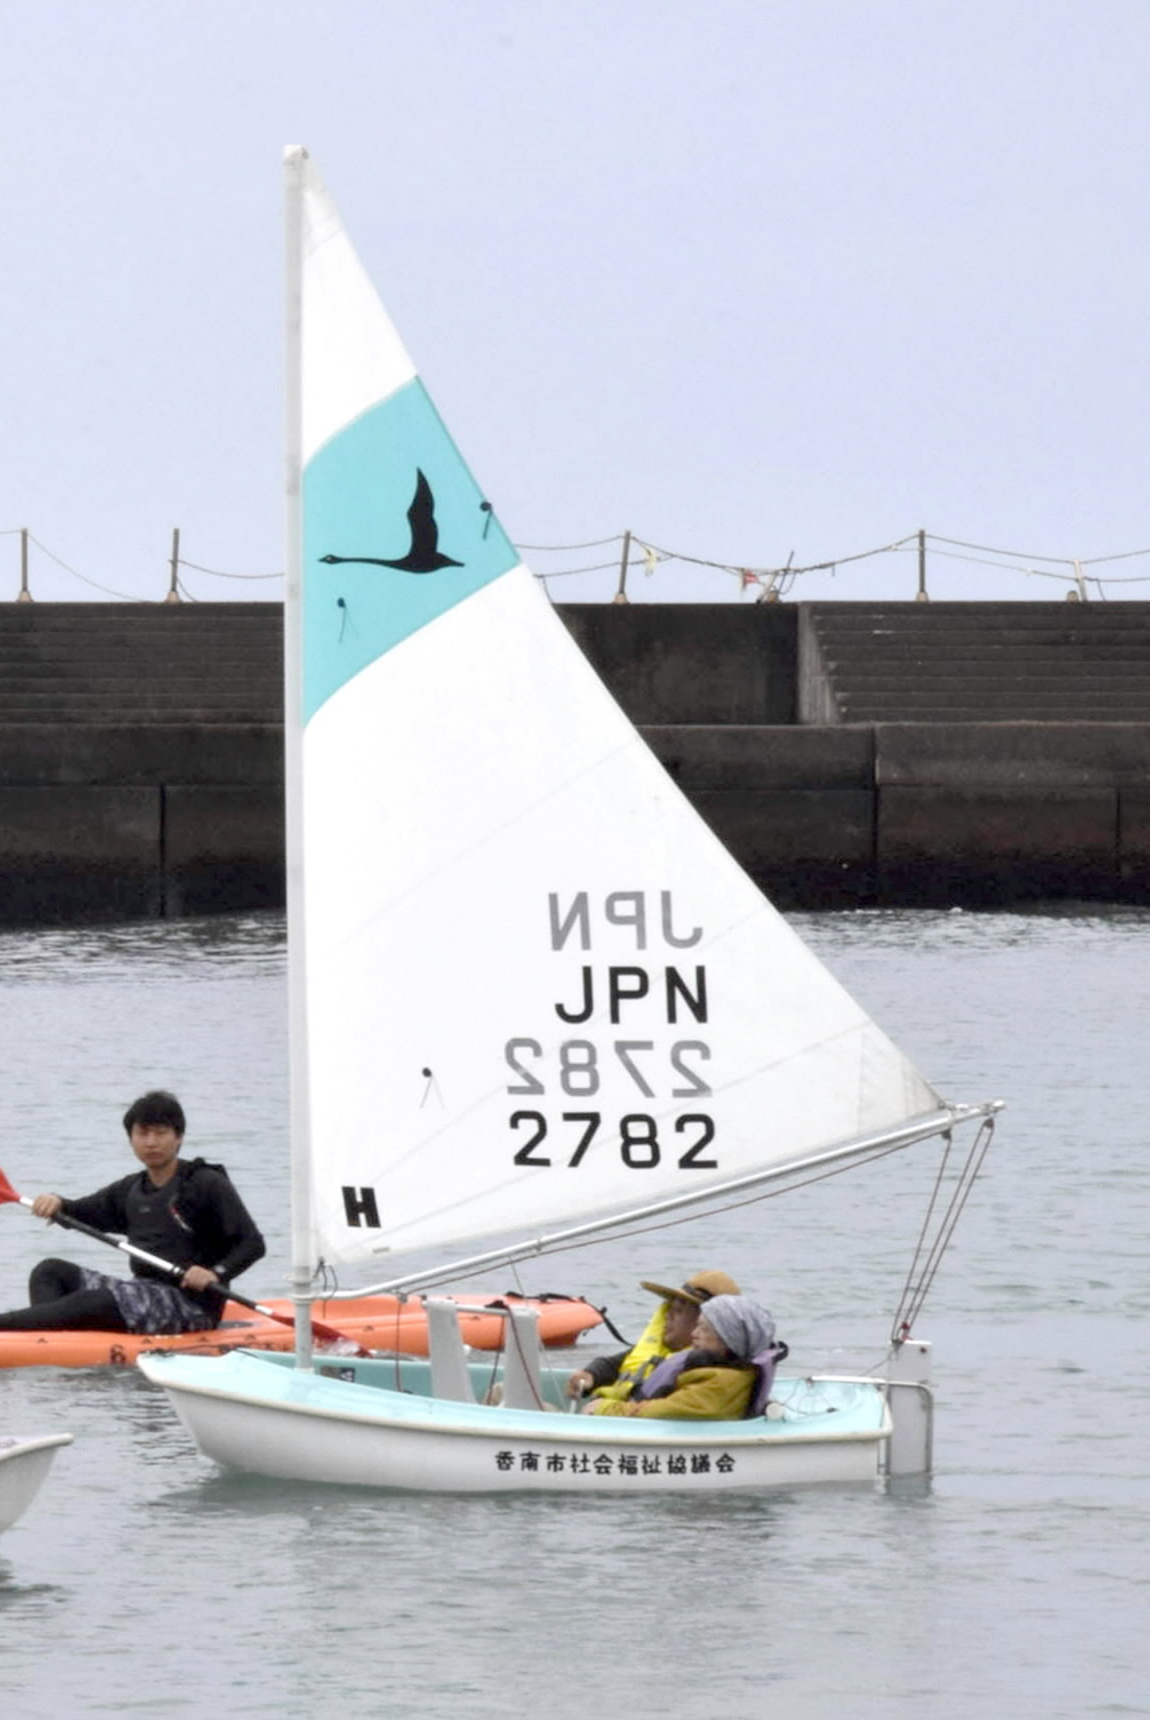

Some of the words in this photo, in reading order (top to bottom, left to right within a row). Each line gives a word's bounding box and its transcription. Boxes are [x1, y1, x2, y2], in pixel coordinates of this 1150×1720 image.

[555, 965, 708, 1025] JPN
[509, 1110, 718, 1169] 2782
[341, 1186, 381, 1228] H
[495, 1450, 736, 1476] 香南市社会福祉協議会
